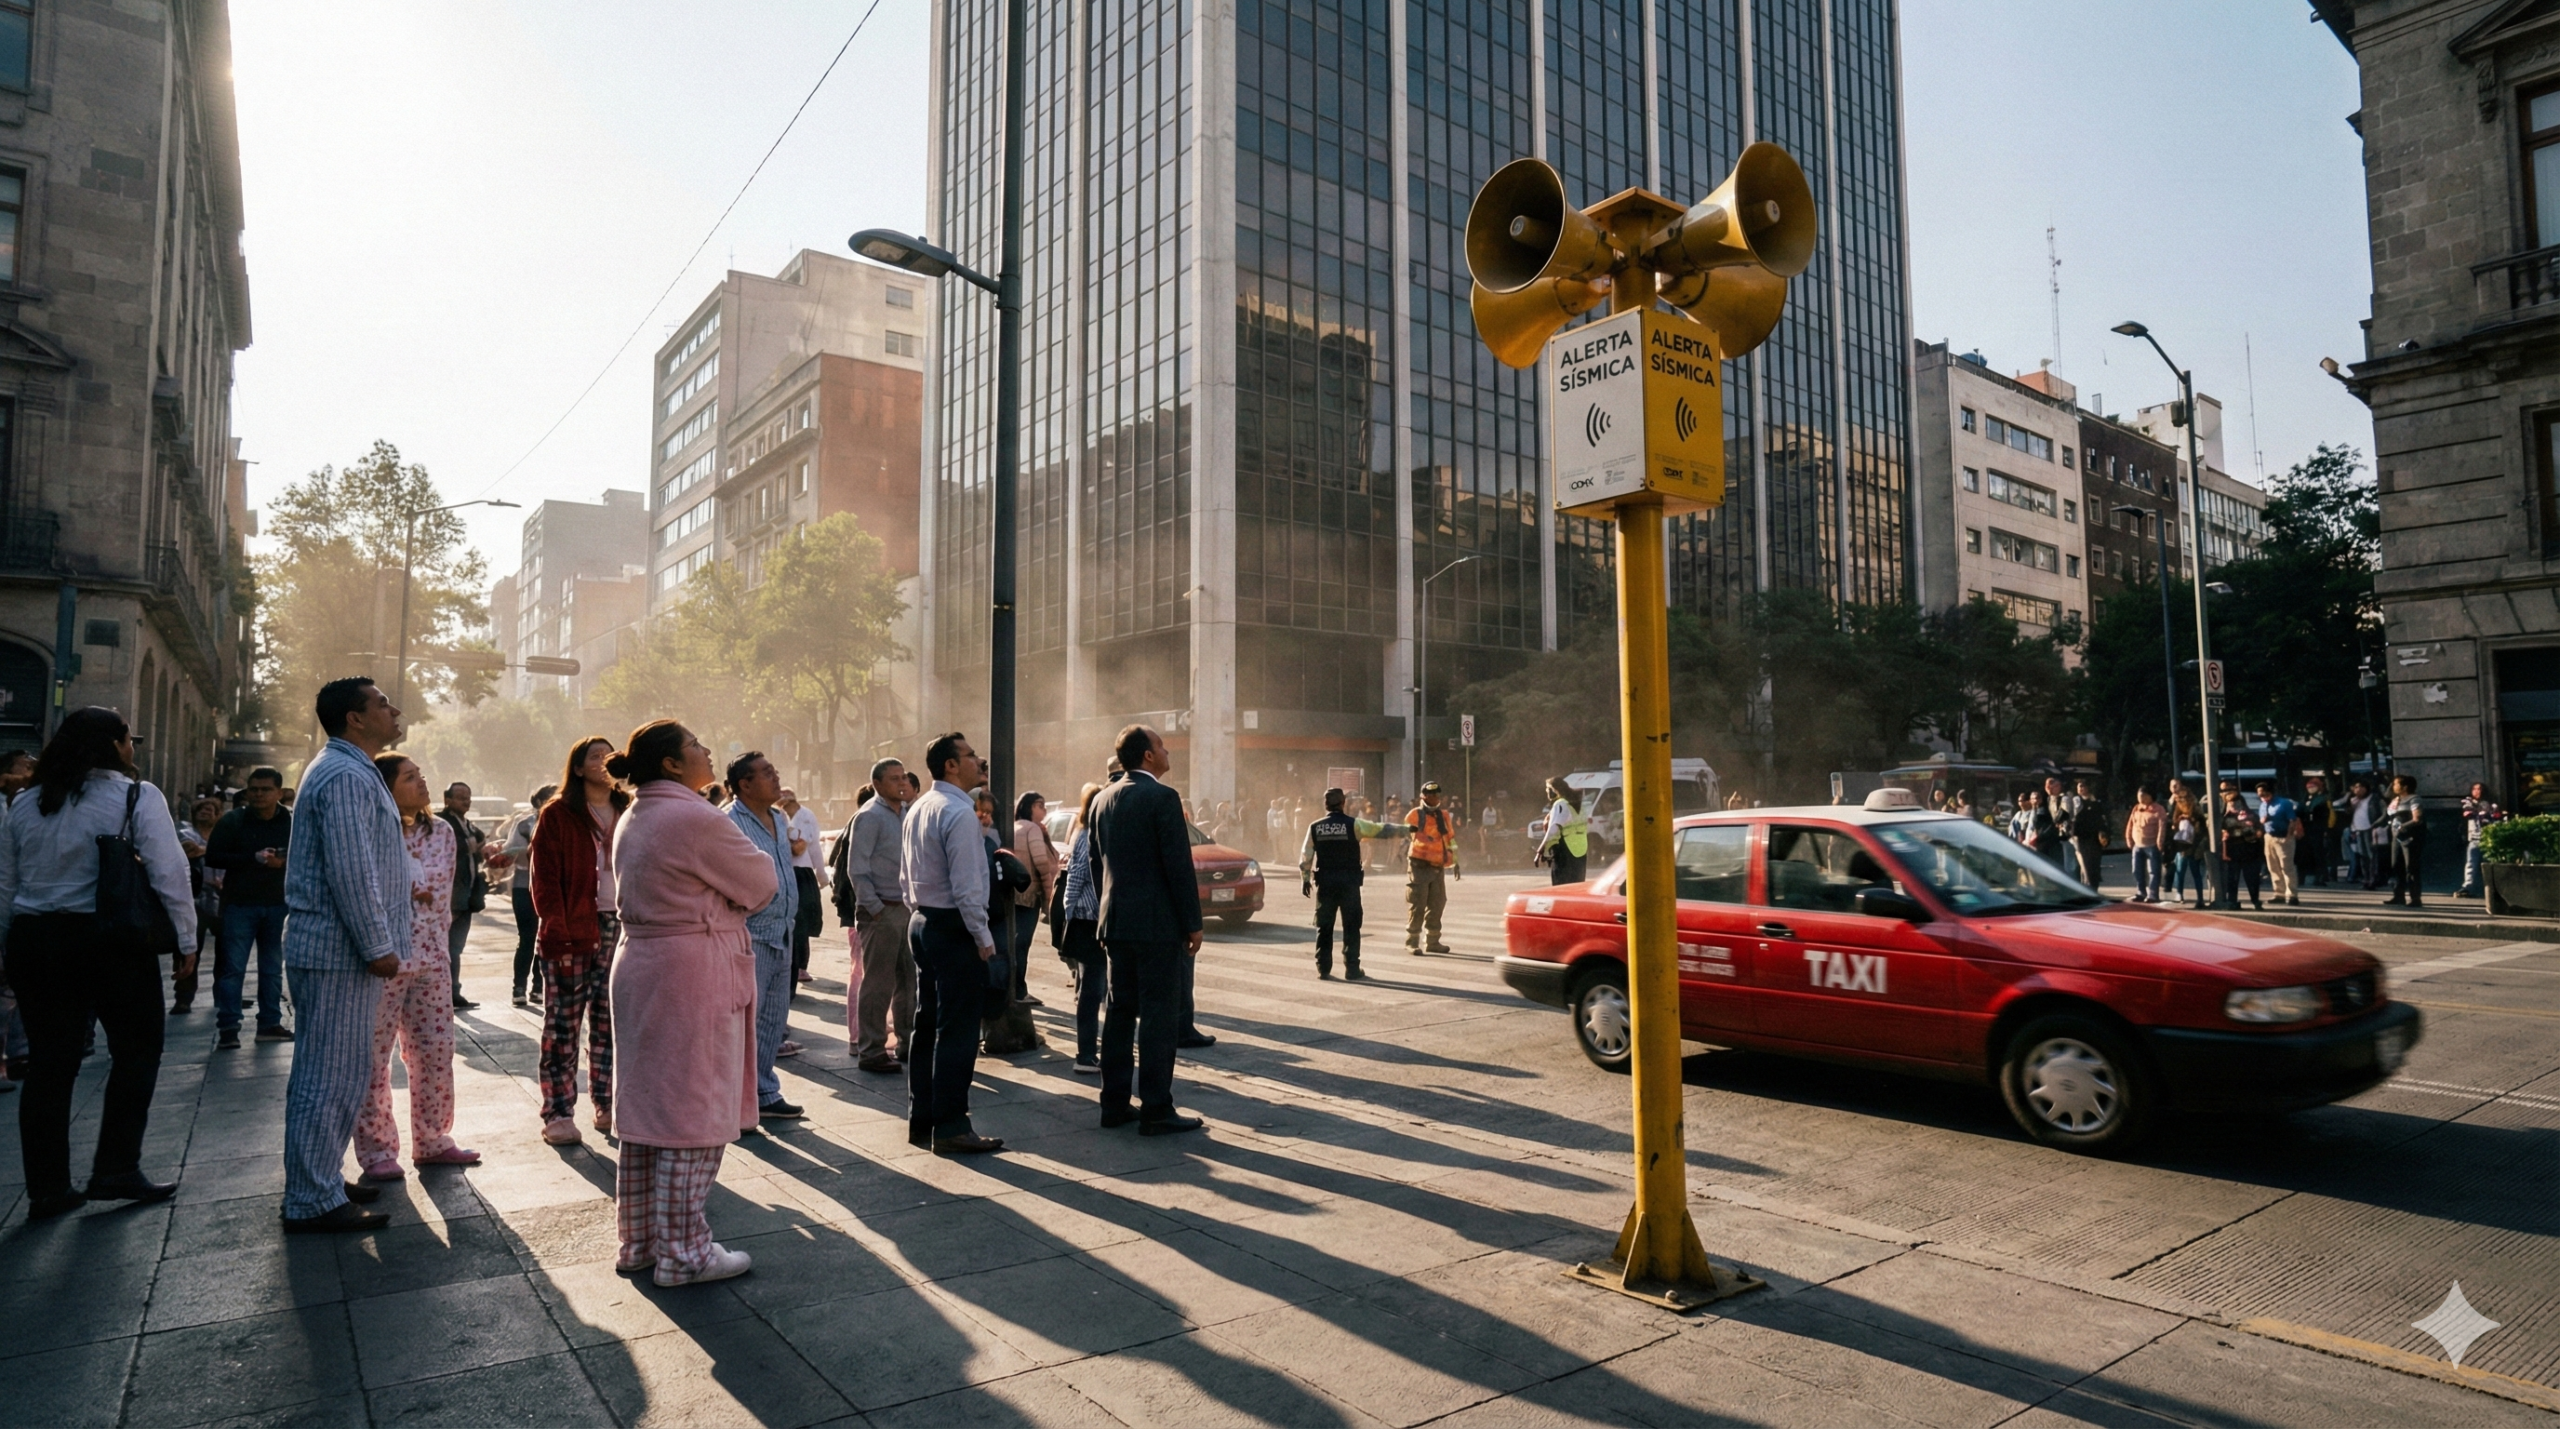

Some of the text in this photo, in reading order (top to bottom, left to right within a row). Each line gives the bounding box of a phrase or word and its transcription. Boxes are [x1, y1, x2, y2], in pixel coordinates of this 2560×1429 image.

[1560, 330, 1633, 369] ALERTA
[1651, 329, 1713, 362] ALERTA
[1560, 355, 1635, 392] SÍSMICA
[1651, 352, 1715, 387] SÍSMICA
[1803, 949, 1888, 994] TAXI
